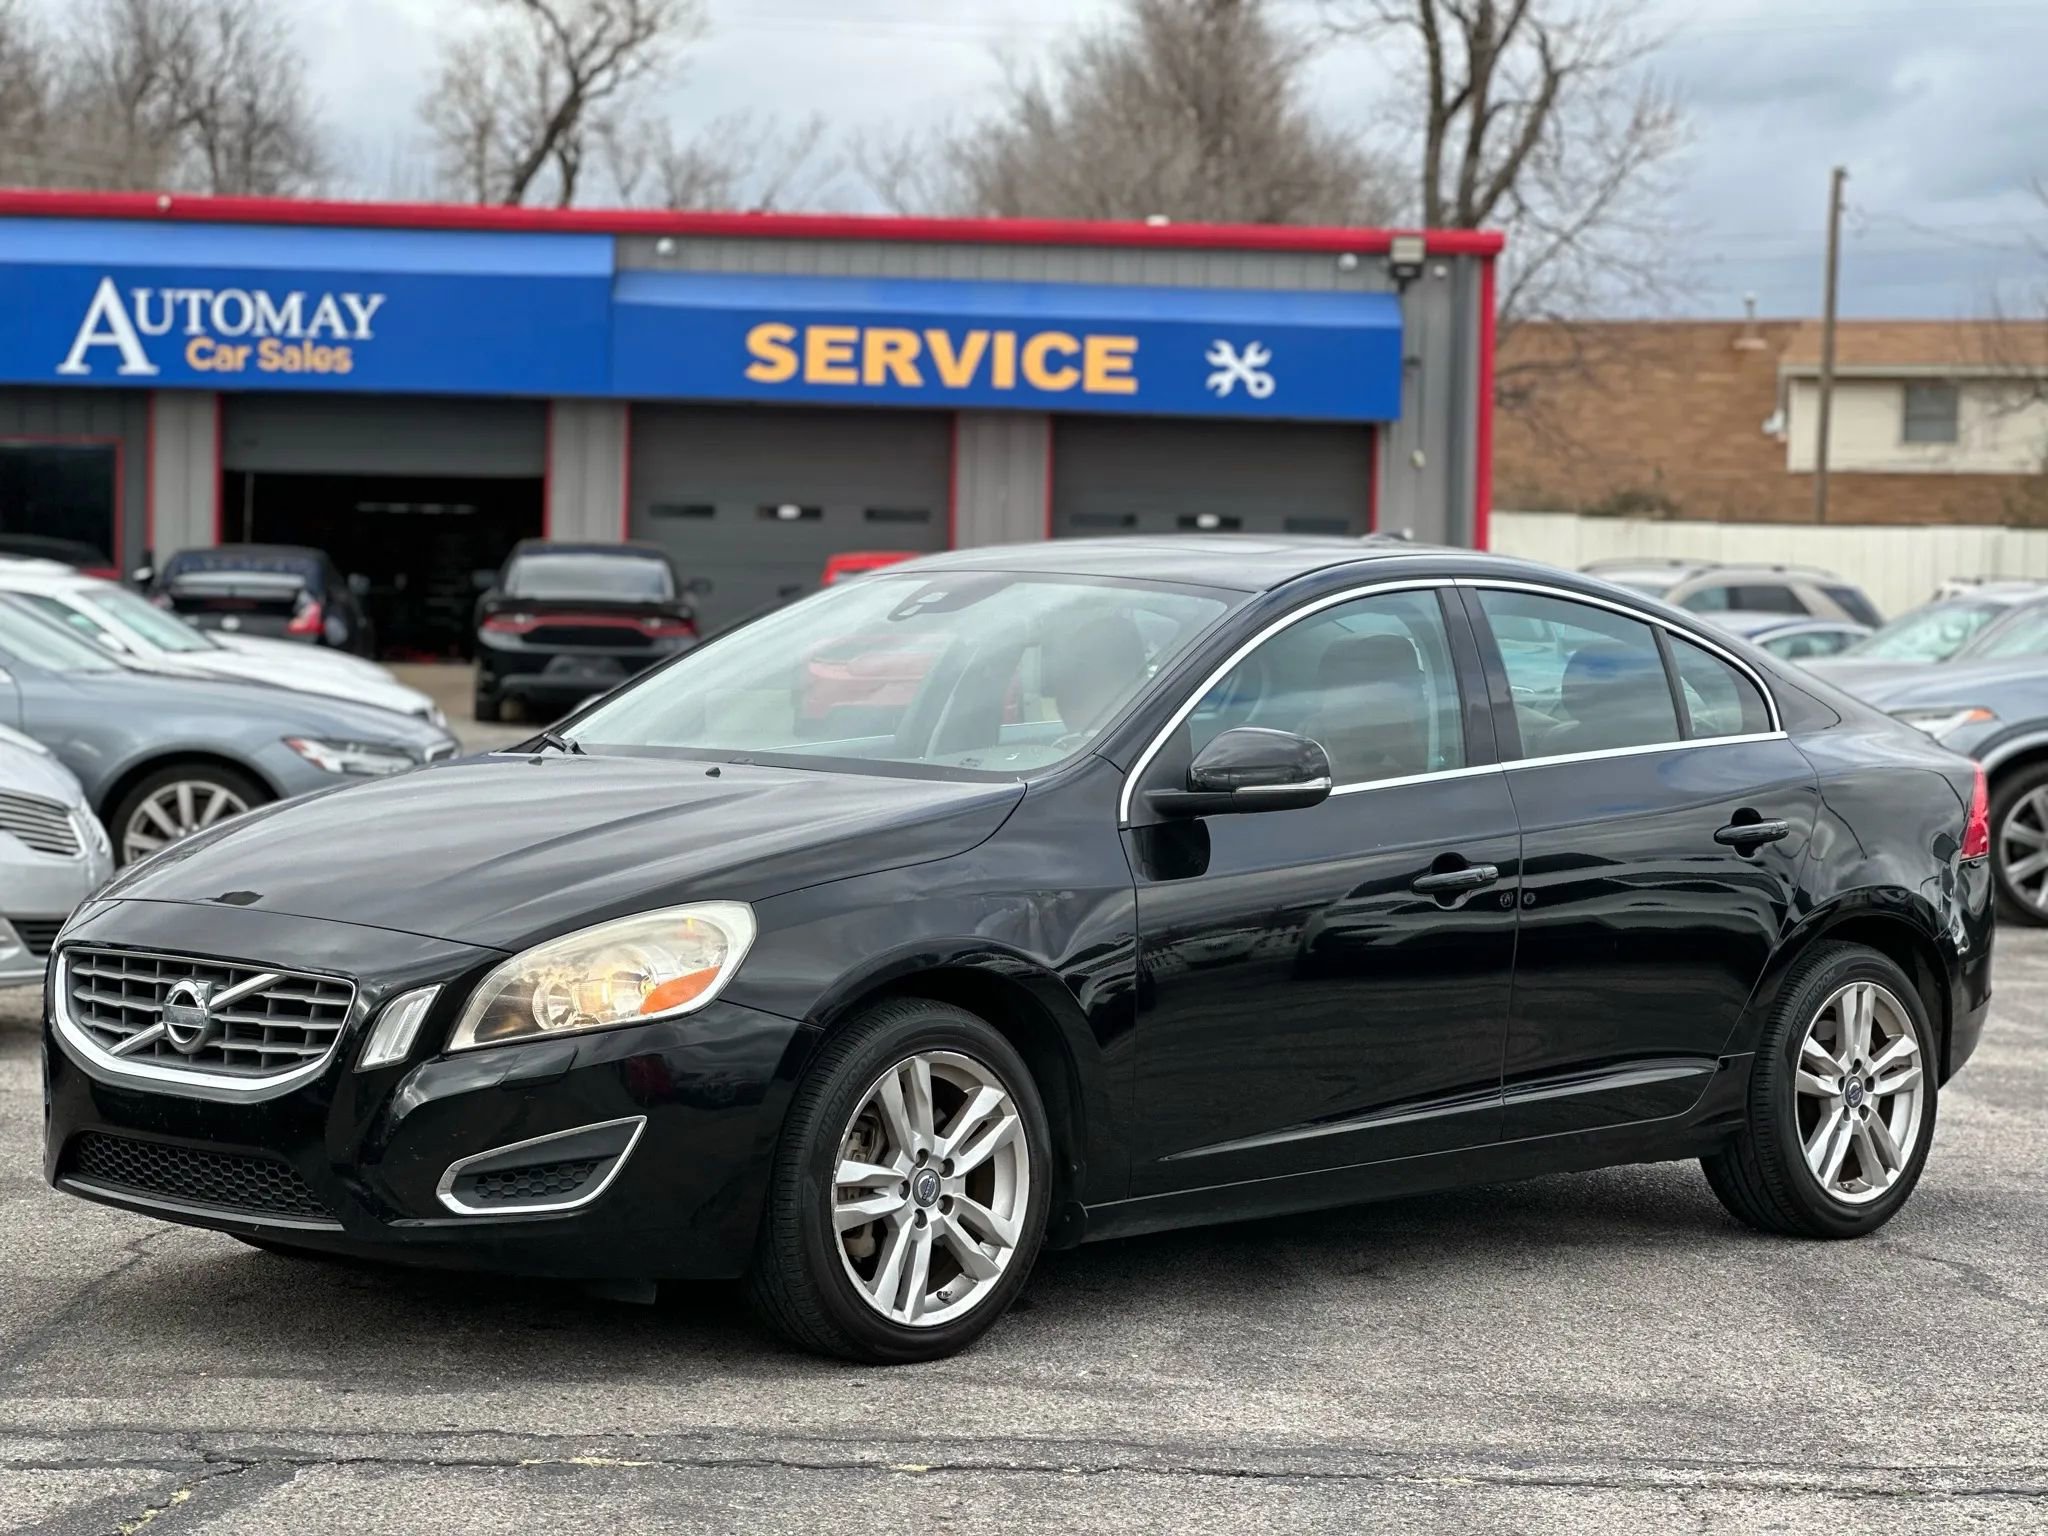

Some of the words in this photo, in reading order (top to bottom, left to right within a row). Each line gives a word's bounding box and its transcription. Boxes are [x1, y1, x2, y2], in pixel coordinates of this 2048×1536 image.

[57, 277, 385, 375] AUTOMAY
[186, 337, 250, 371] Car
[258, 338, 352, 373] Sales
[745, 323, 1138, 393] SERVICE
